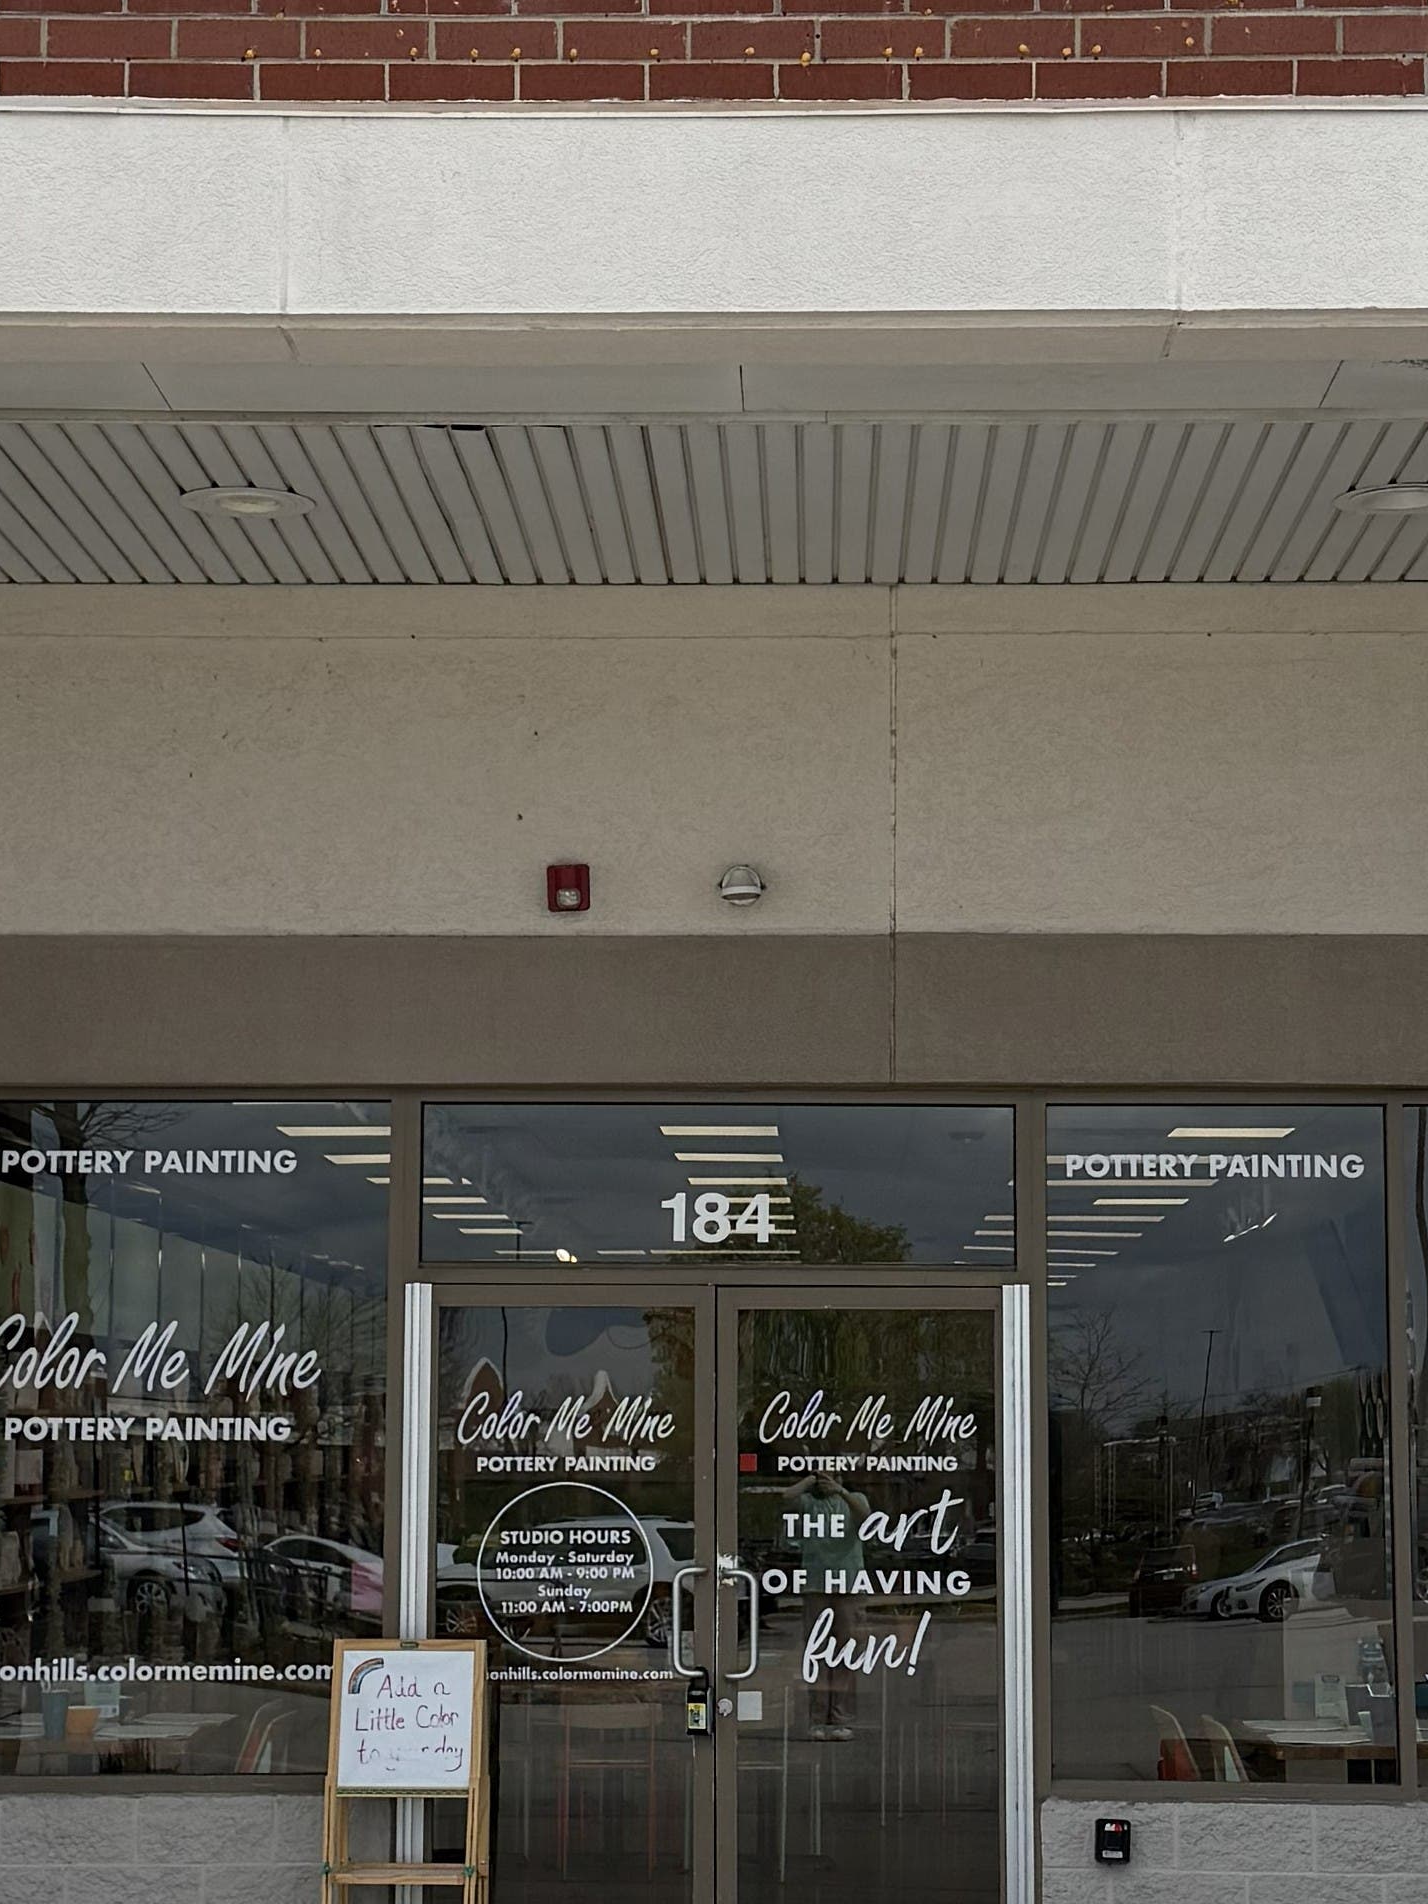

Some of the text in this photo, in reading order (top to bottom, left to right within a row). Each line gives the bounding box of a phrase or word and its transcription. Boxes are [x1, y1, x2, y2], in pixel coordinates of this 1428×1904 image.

[2, 1150, 297, 1174] POTTERY PAINTING
[1065, 1154, 1365, 1181] POTTERY PAINTING
[660, 1192, 775, 1244] 184
[111, 1320, 190, 1394] Me
[203, 1321, 322, 1402] Mine
[2, 1416, 292, 1441] POTTERY PAINTING
[457, 1390, 676, 1446] Color Me Mine
[758, 1389, 978, 1447] Color Me Mine
[476, 1455, 657, 1473] POTTERY PAINTING
[777, 1455, 959, 1472] POTTERY PAINTING
[782, 1488, 965, 1555] THE art
[500, 1529, 632, 1545] STUDIO HOURS
[495, 1551, 556, 1566] Monday
[567, 1550, 635, 1566] Saturday
[495, 1567, 535, 1580] 10:00
[538, 1567, 563, 1580] AM
[576, 1567, 608, 1580] 9:00
[612, 1567, 636, 1579] PM
[761, 1568, 972, 1596] OF HAVING
[537, 1584, 592, 1600] Sunday
[501, 1601, 537, 1614] 11:00
[540, 1601, 566, 1614] AM
[579, 1601, 633, 1613] 7:00PM
[802, 1607, 932, 1684] fun!
[486, 1666, 675, 1682] onhills.colormemine.com
[355, 1703, 460, 1732] Little Color
